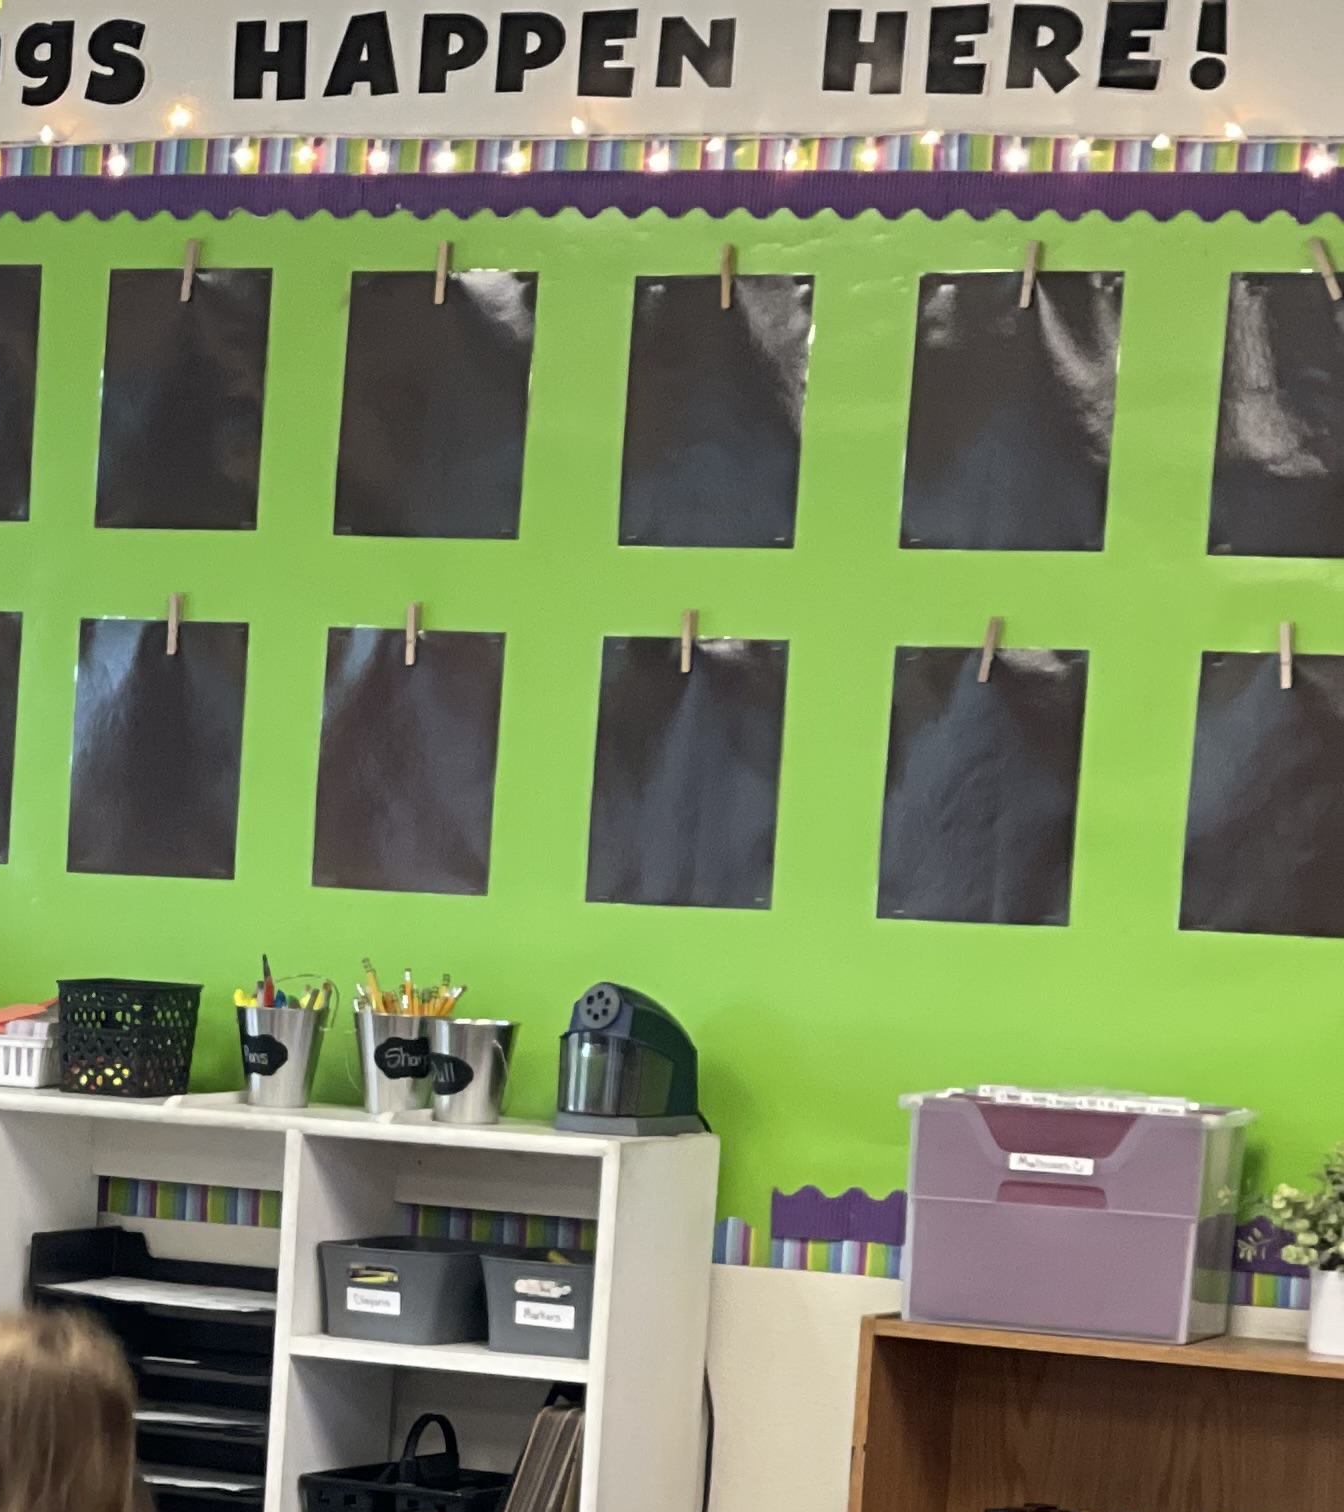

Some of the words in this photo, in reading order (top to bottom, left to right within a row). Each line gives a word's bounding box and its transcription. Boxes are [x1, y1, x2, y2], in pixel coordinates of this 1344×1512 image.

[232, 8, 736, 100] HAPPEN
[822, 0, 1227, 95] HERE!
[523, 1306, 562, 1323] Markers
